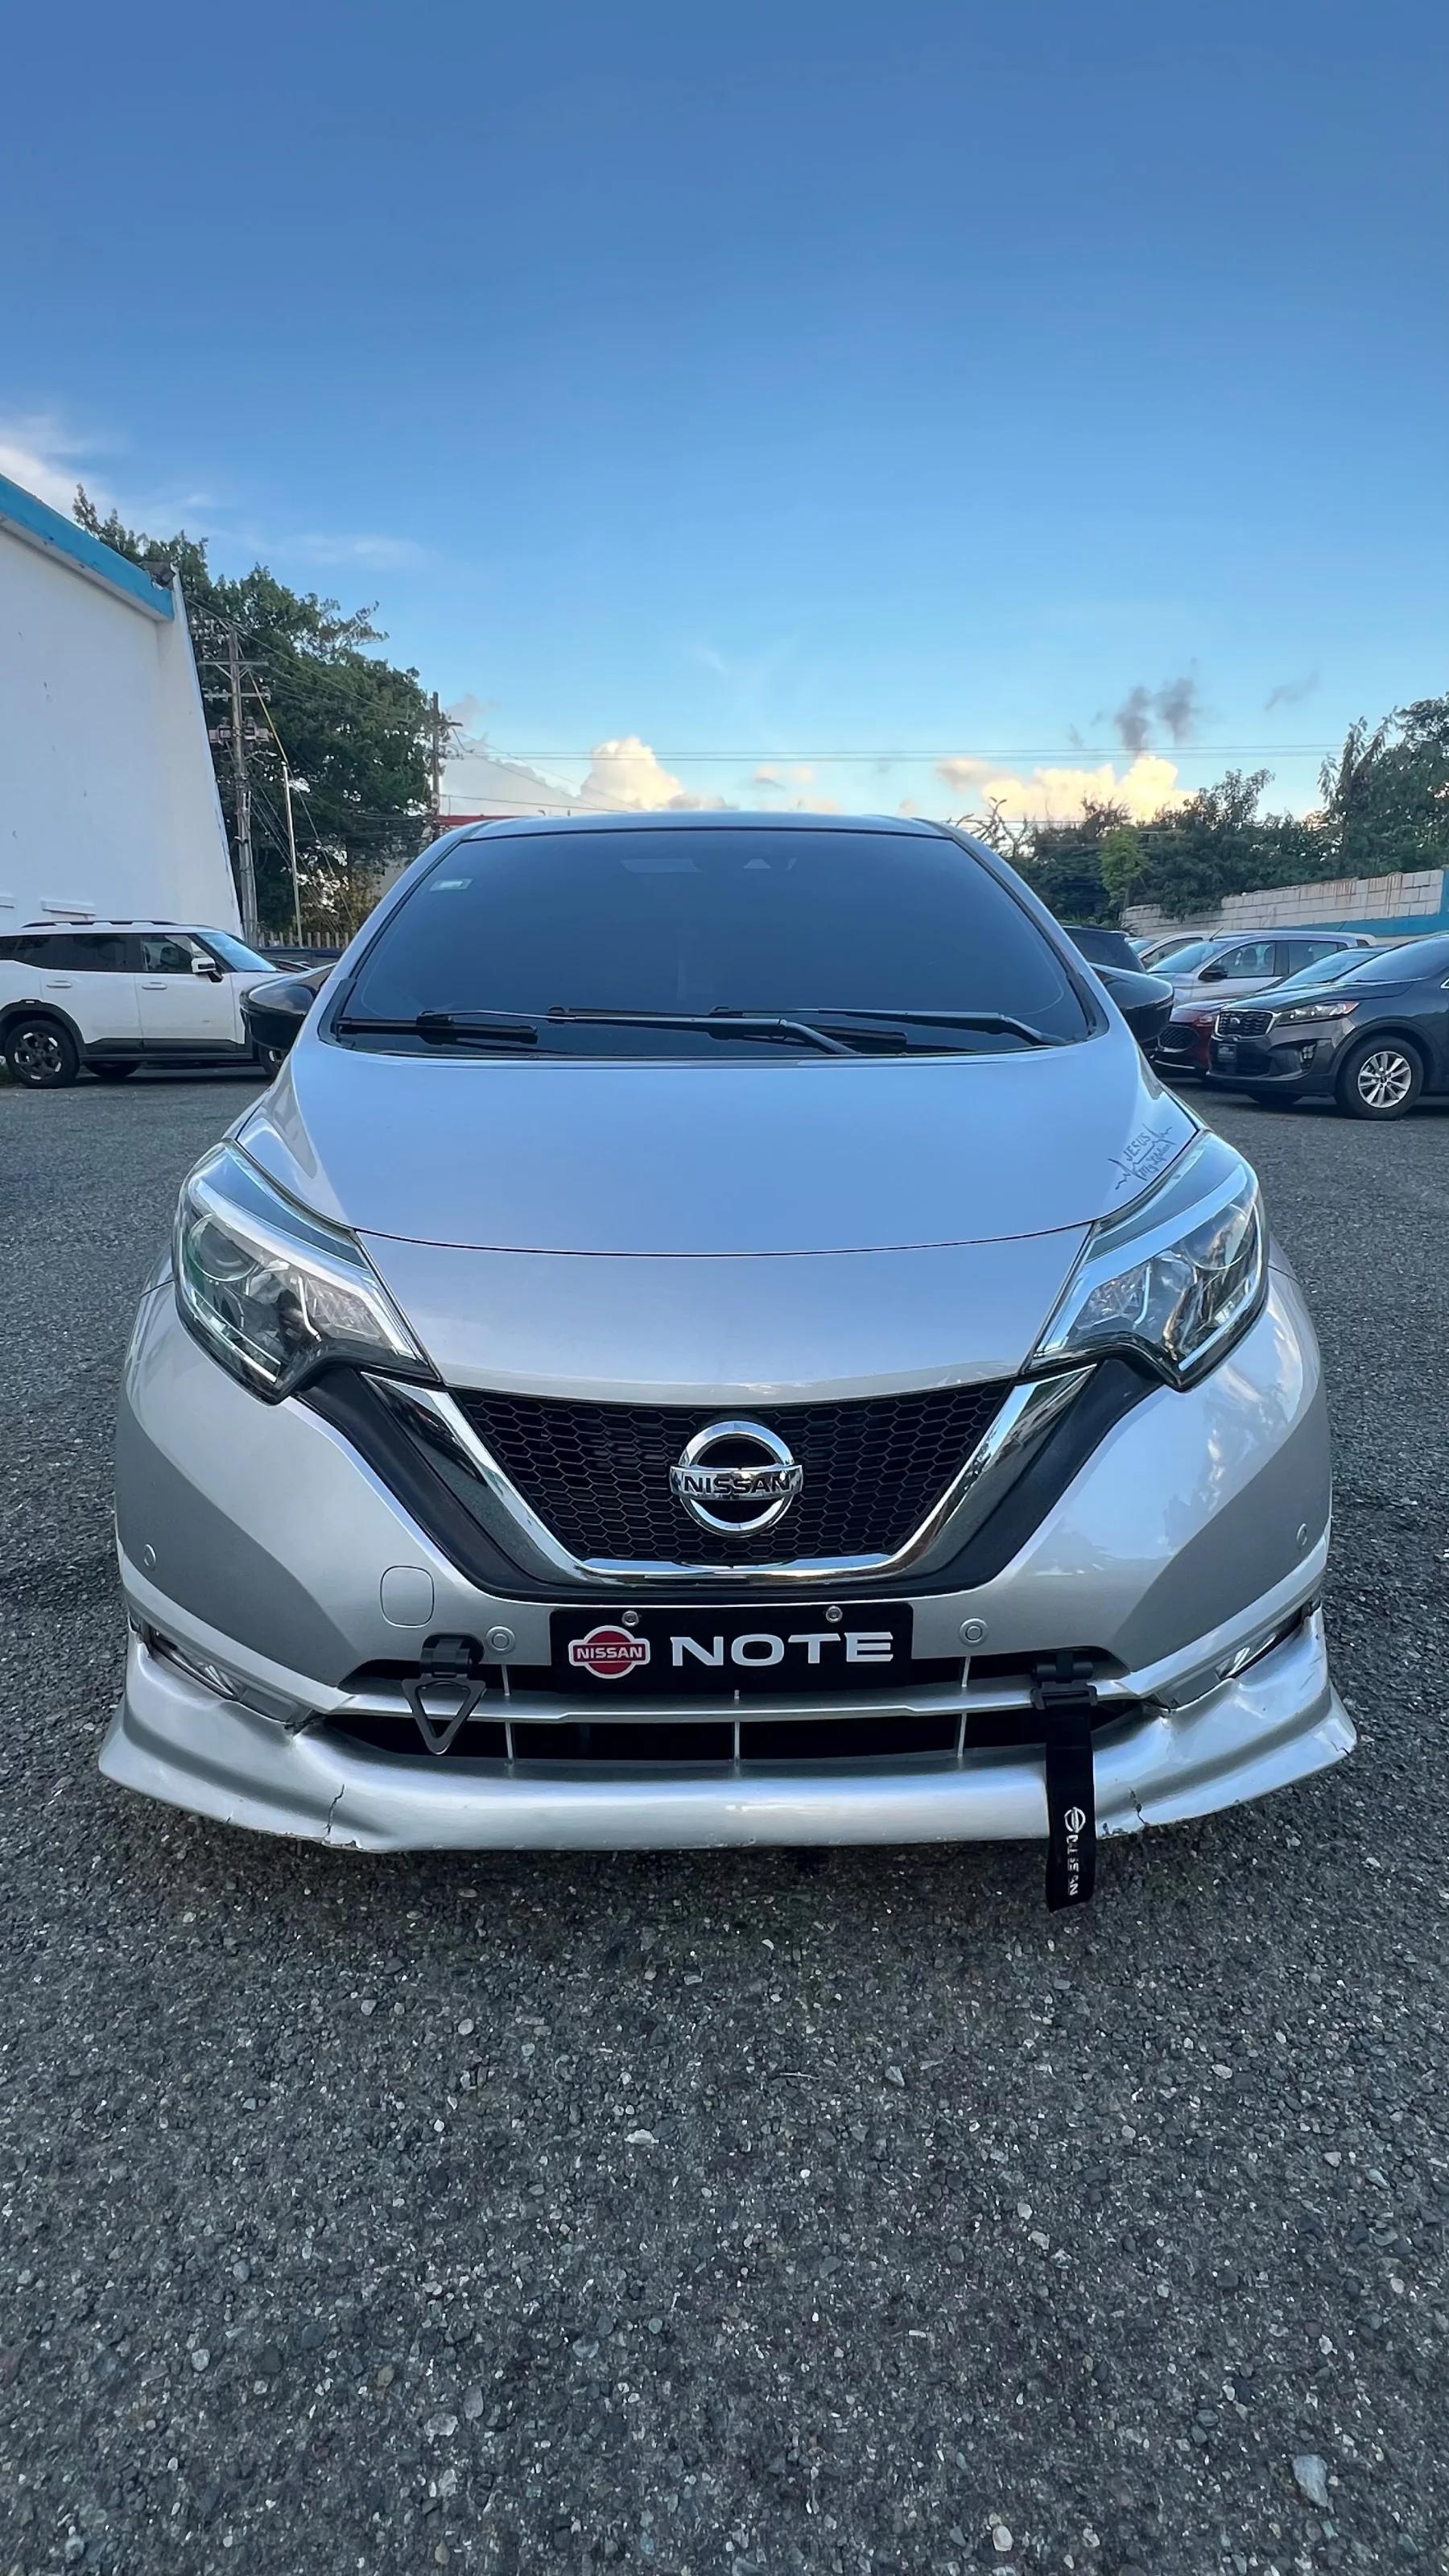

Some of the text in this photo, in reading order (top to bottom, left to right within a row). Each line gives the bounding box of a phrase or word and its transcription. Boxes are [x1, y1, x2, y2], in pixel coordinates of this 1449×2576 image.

[1124, 1132, 1151, 1161] JESUS
[684, 1472, 791, 1494] NISSAN
[576, 1632, 894, 1666] NISSAN NOTE
